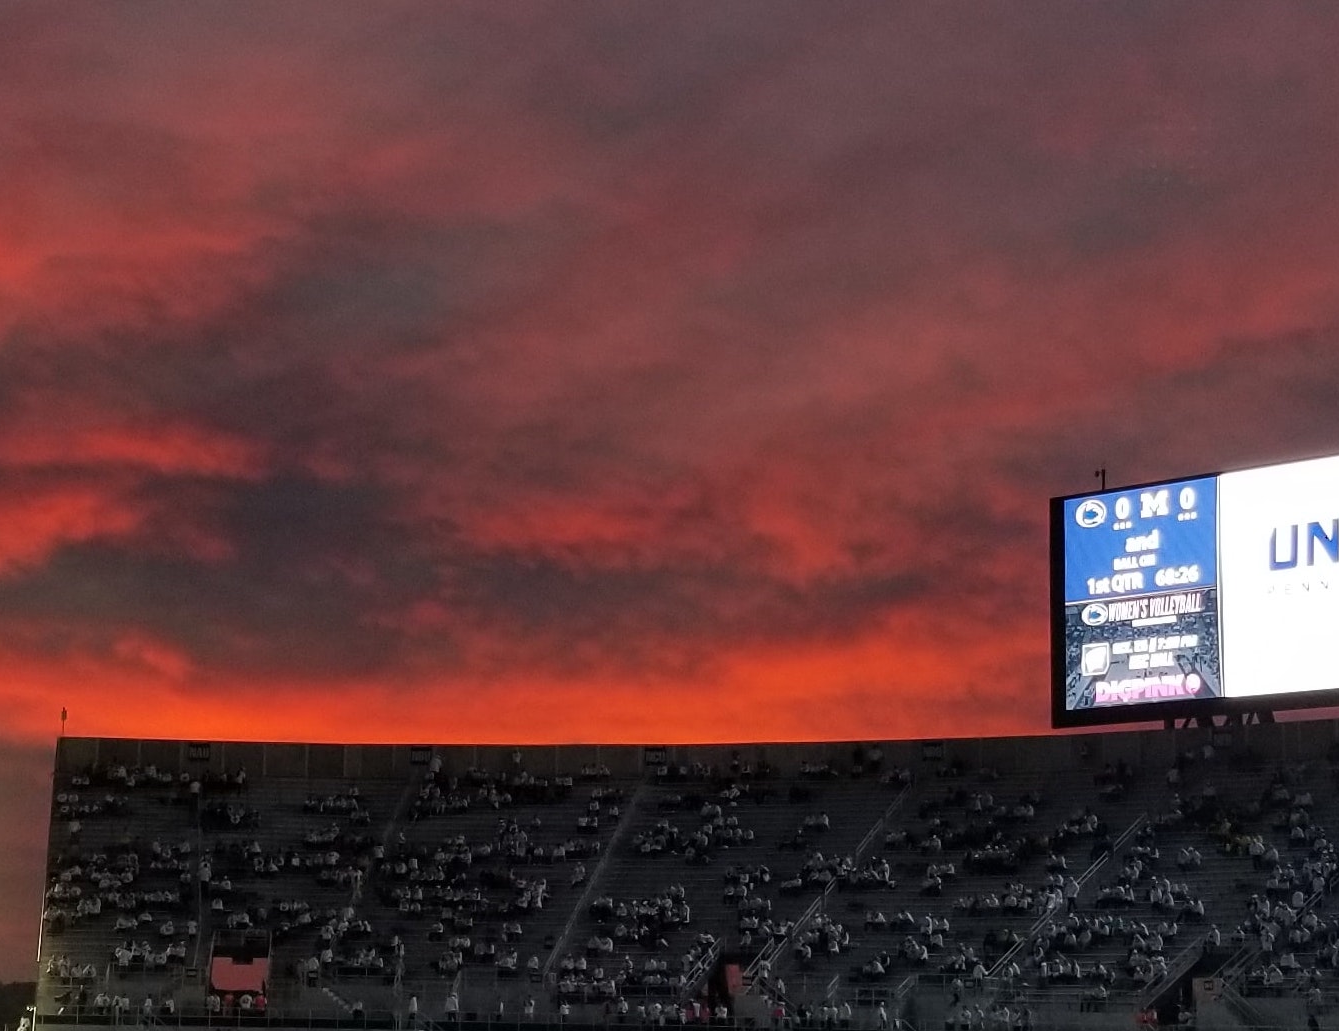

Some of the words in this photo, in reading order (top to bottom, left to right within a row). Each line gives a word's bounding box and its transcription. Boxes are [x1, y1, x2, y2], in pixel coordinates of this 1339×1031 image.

[1115, 496, 1130, 520] 0
[1179, 487, 1195, 510] 0
[1087, 577, 1110, 595] 1st
[1112, 571, 1144, 592] QTR
[1266, 580, 1330, 595] PENN
[1108, 600, 1149, 622] WOMEN'S
[1150, 593, 1202, 617] VOLLEYBALL
